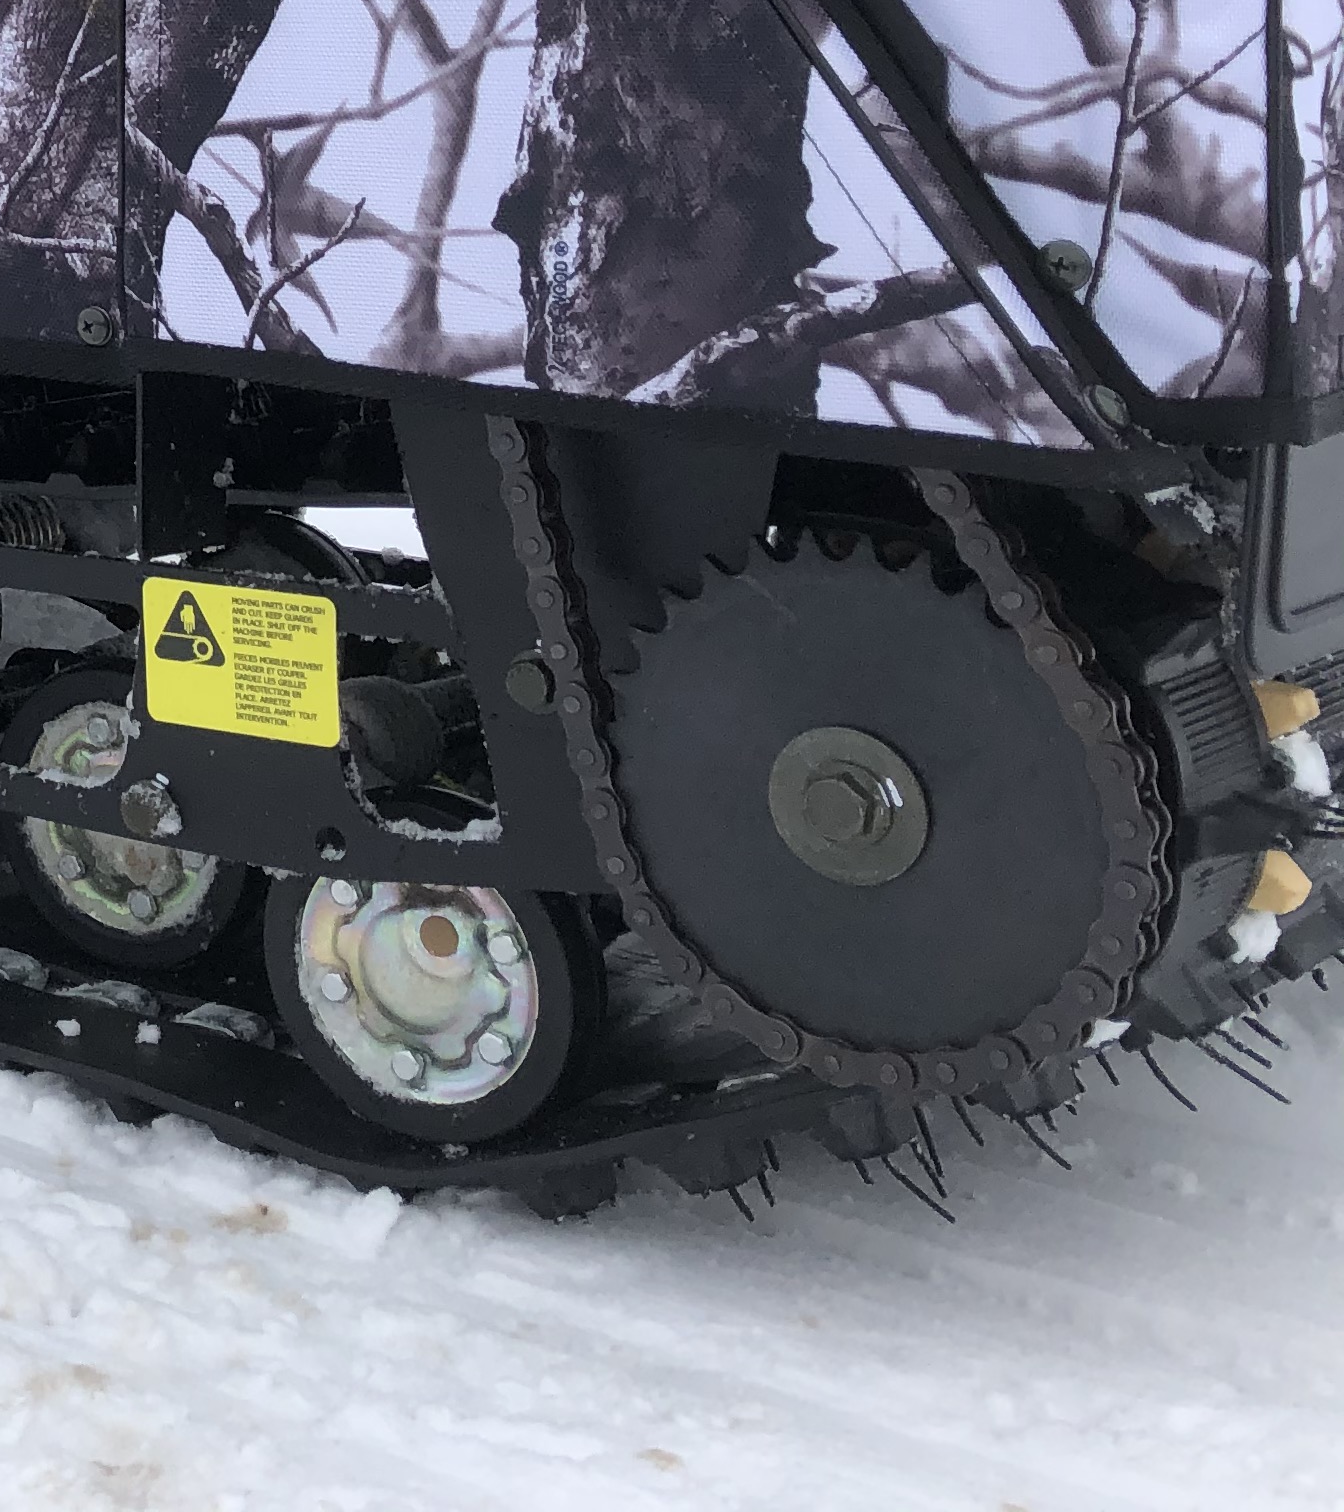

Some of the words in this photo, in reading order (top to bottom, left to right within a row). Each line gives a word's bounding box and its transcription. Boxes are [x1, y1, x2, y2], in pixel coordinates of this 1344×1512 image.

[232, 607, 246, 615] AND
[265, 611, 282, 619] KEEP
[261, 601, 283, 610] PARTS
[285, 603, 299, 612] CAN
[301, 605, 325, 615] CRUSH
[267, 621, 285, 630] SHUT
[287, 623, 300, 631] OFF
[304, 626, 317, 635] THE
[266, 630, 293, 641] BEFORE
[235, 682, 244, 690] DE
[299, 711, 318, 721] TOUT
